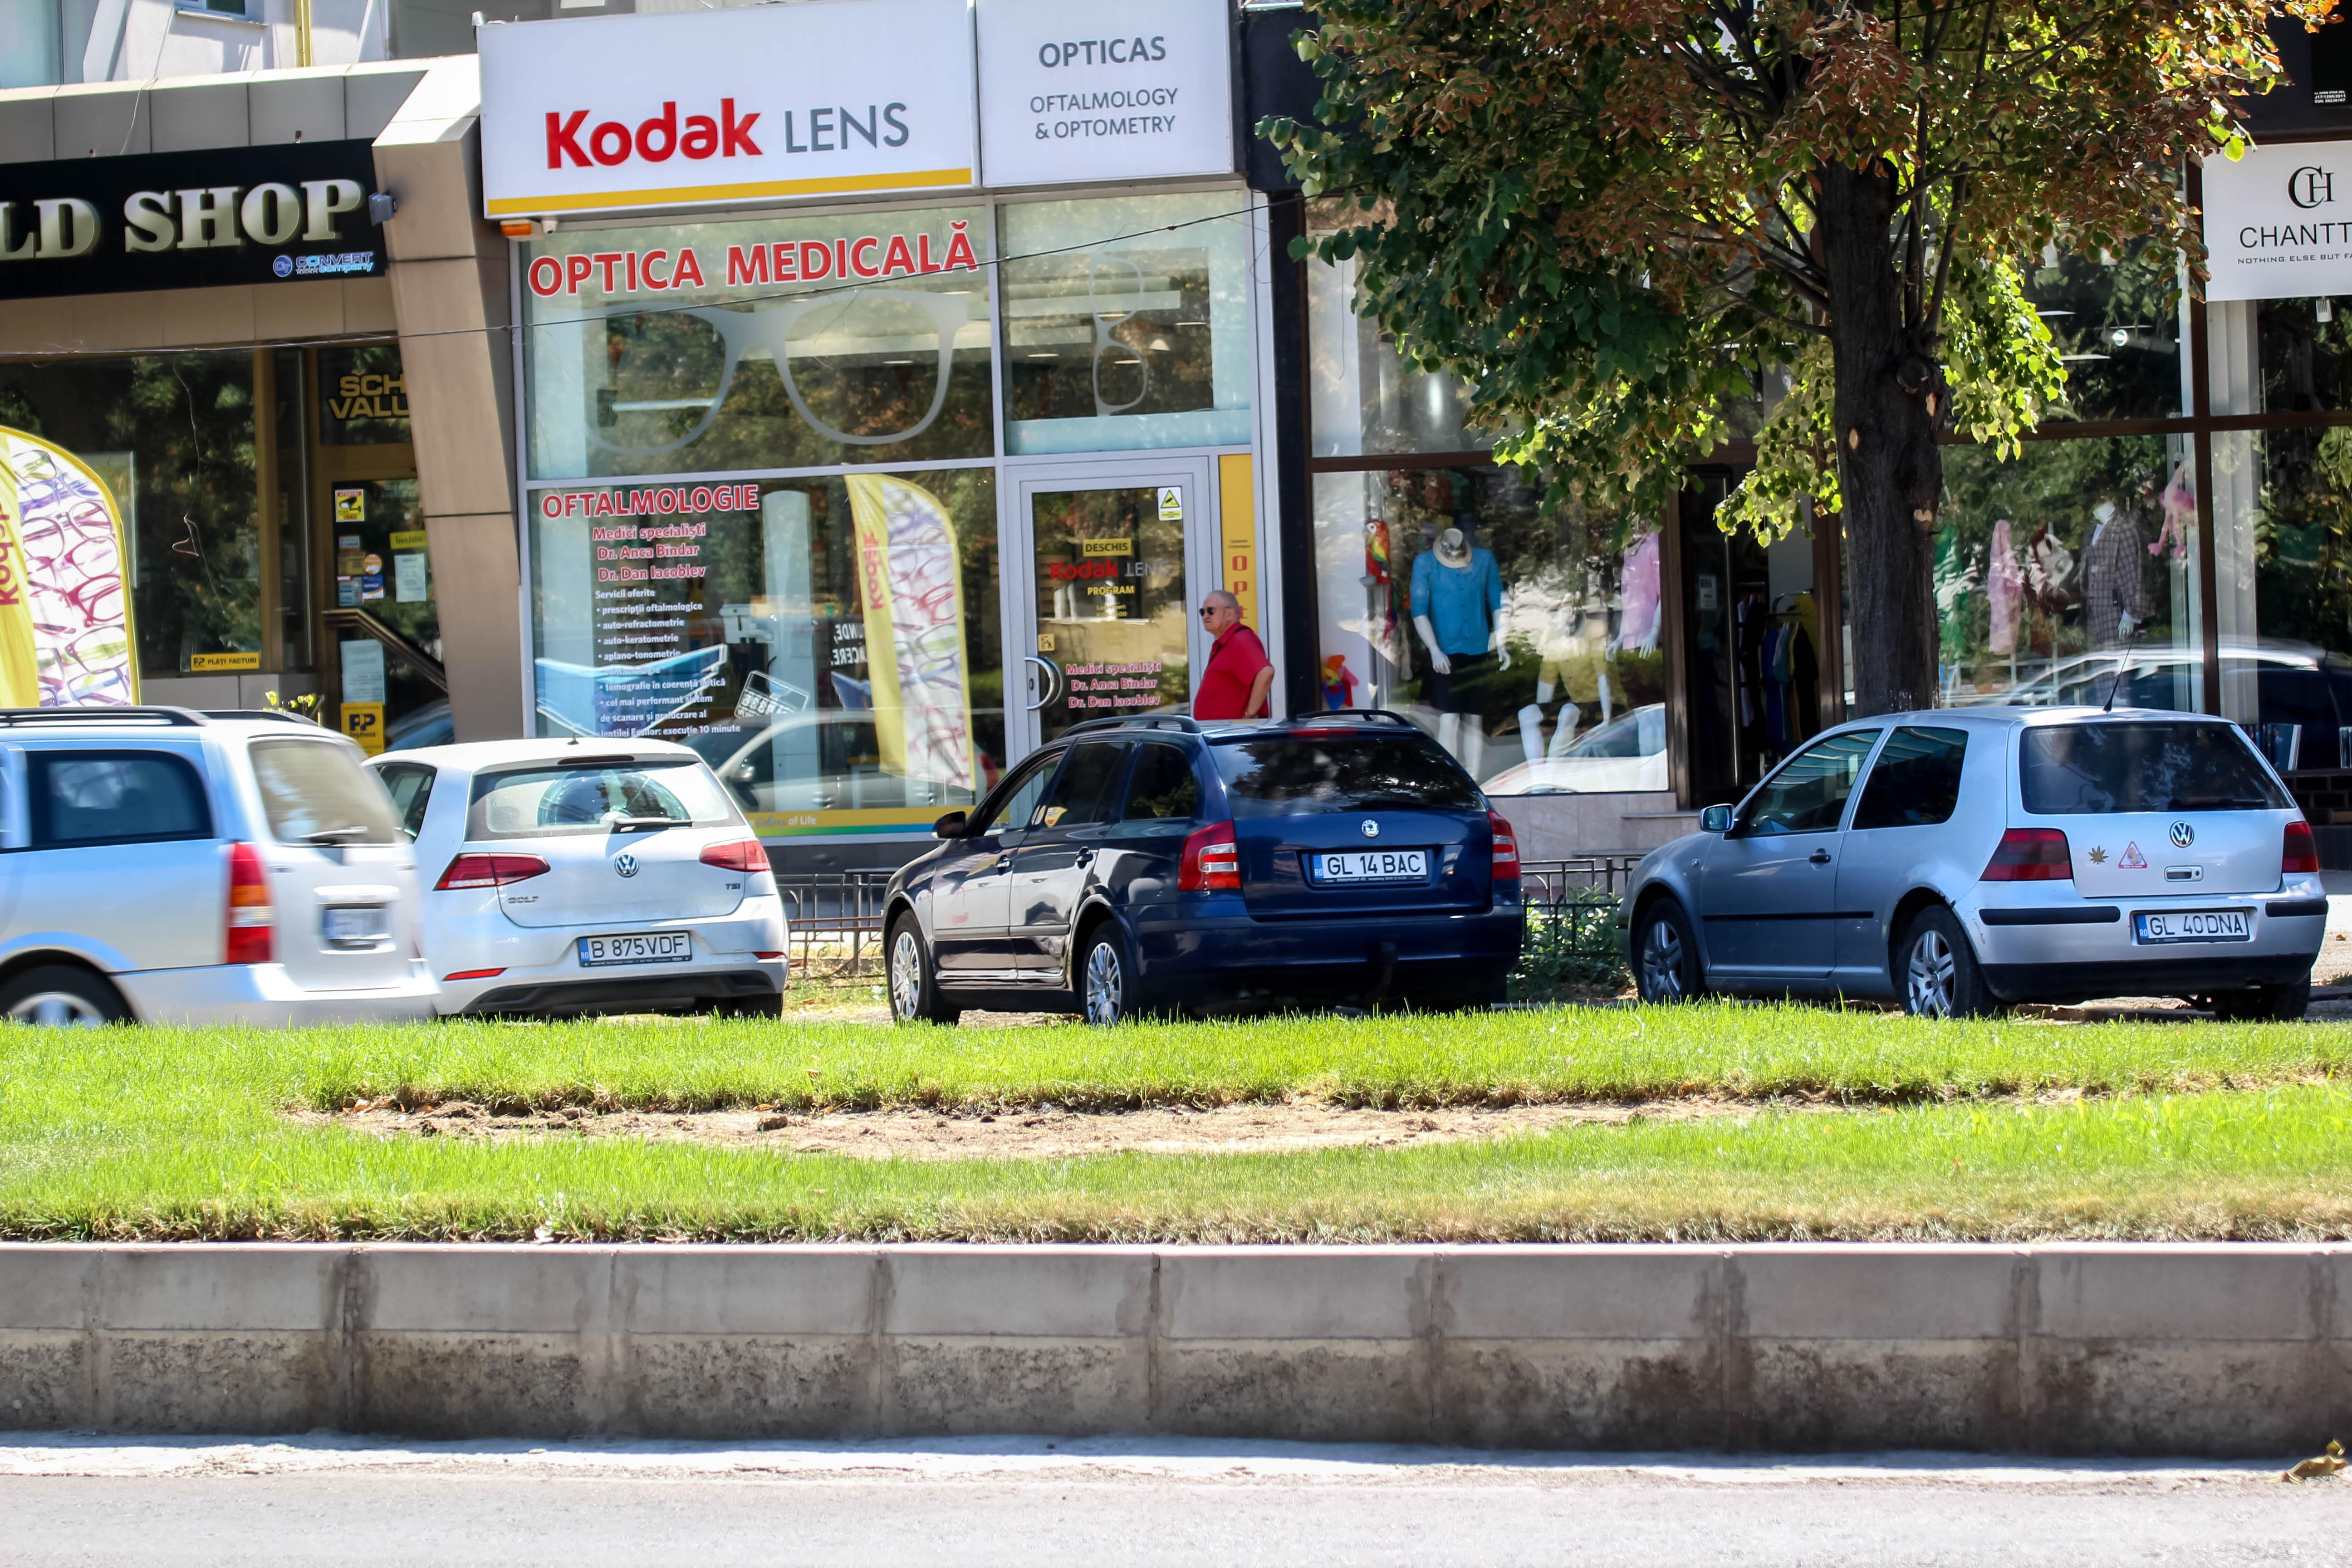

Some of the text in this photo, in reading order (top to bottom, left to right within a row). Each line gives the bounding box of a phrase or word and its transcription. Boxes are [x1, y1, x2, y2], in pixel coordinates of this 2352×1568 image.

[1039, 36, 1166, 68] OPTICAS
[1030, 88, 1178, 113] OFTALMOLOGY
[545, 98, 909, 169] Kodak LENS
[1035, 115, 1176, 139] & OPTOMETRY
[124, 179, 364, 253] SHOP
[2239, 222, 2352, 248] CHANTT
[296, 251, 373, 268] CONVERT
[528, 220, 979, 297] OPTICA MEDICALĂ
[318, 262, 373, 273] company
[542, 484, 760, 519] OFTALMOLOGIE
[593, 525, 637, 541] Medici
[598, 547, 617, 560] Dr.
[620, 545, 654, 559] Anca
[1086, 543, 1128, 552] DESCHIS
[598, 564, 706, 582] Dr. Dan Iacoblev
[1049, 559, 1170, 579] Kodak LENS
[595, 588, 656, 599] Servicii oferite
[1087, 585, 1134, 595] PROGRAM
[646, 601, 703, 612] oftalmologice
[603, 617, 685, 630] auto-refractometrie
[603, 633, 679, 645] auto-keratometrie
[1066, 663, 1103, 675] Medici
[605, 680, 650, 693] tomografie
[652, 680, 660, 689] în
[1071, 679, 1088, 691] Dr.
[1090, 678, 1119, 691] Anca
[606, 698, 617, 706] cel
[619, 698, 635, 706] mai
[637, 696, 683, 708] performant
[1068, 694, 1161, 709] Dr. Dan Iacoblev
[600, 714, 610, 723] de
[612, 714, 644, 722] scanare
[699, 710, 707, 718] al
[700, 725, 709, 734] 10
[711, 724, 741, 733] minute
[789, 815, 799, 825] of
[800, 815, 816, 825] Life
[1328, 854, 1421, 875] GL 14 BAC
[1314, 868, 1323, 877] RO
[507, 896, 539, 904] GOLF
[2139, 929, 2147, 937] RO
[2150, 917, 2175, 936] GL
[580, 951, 589, 960] RO
[591, 941, 605, 958] B
